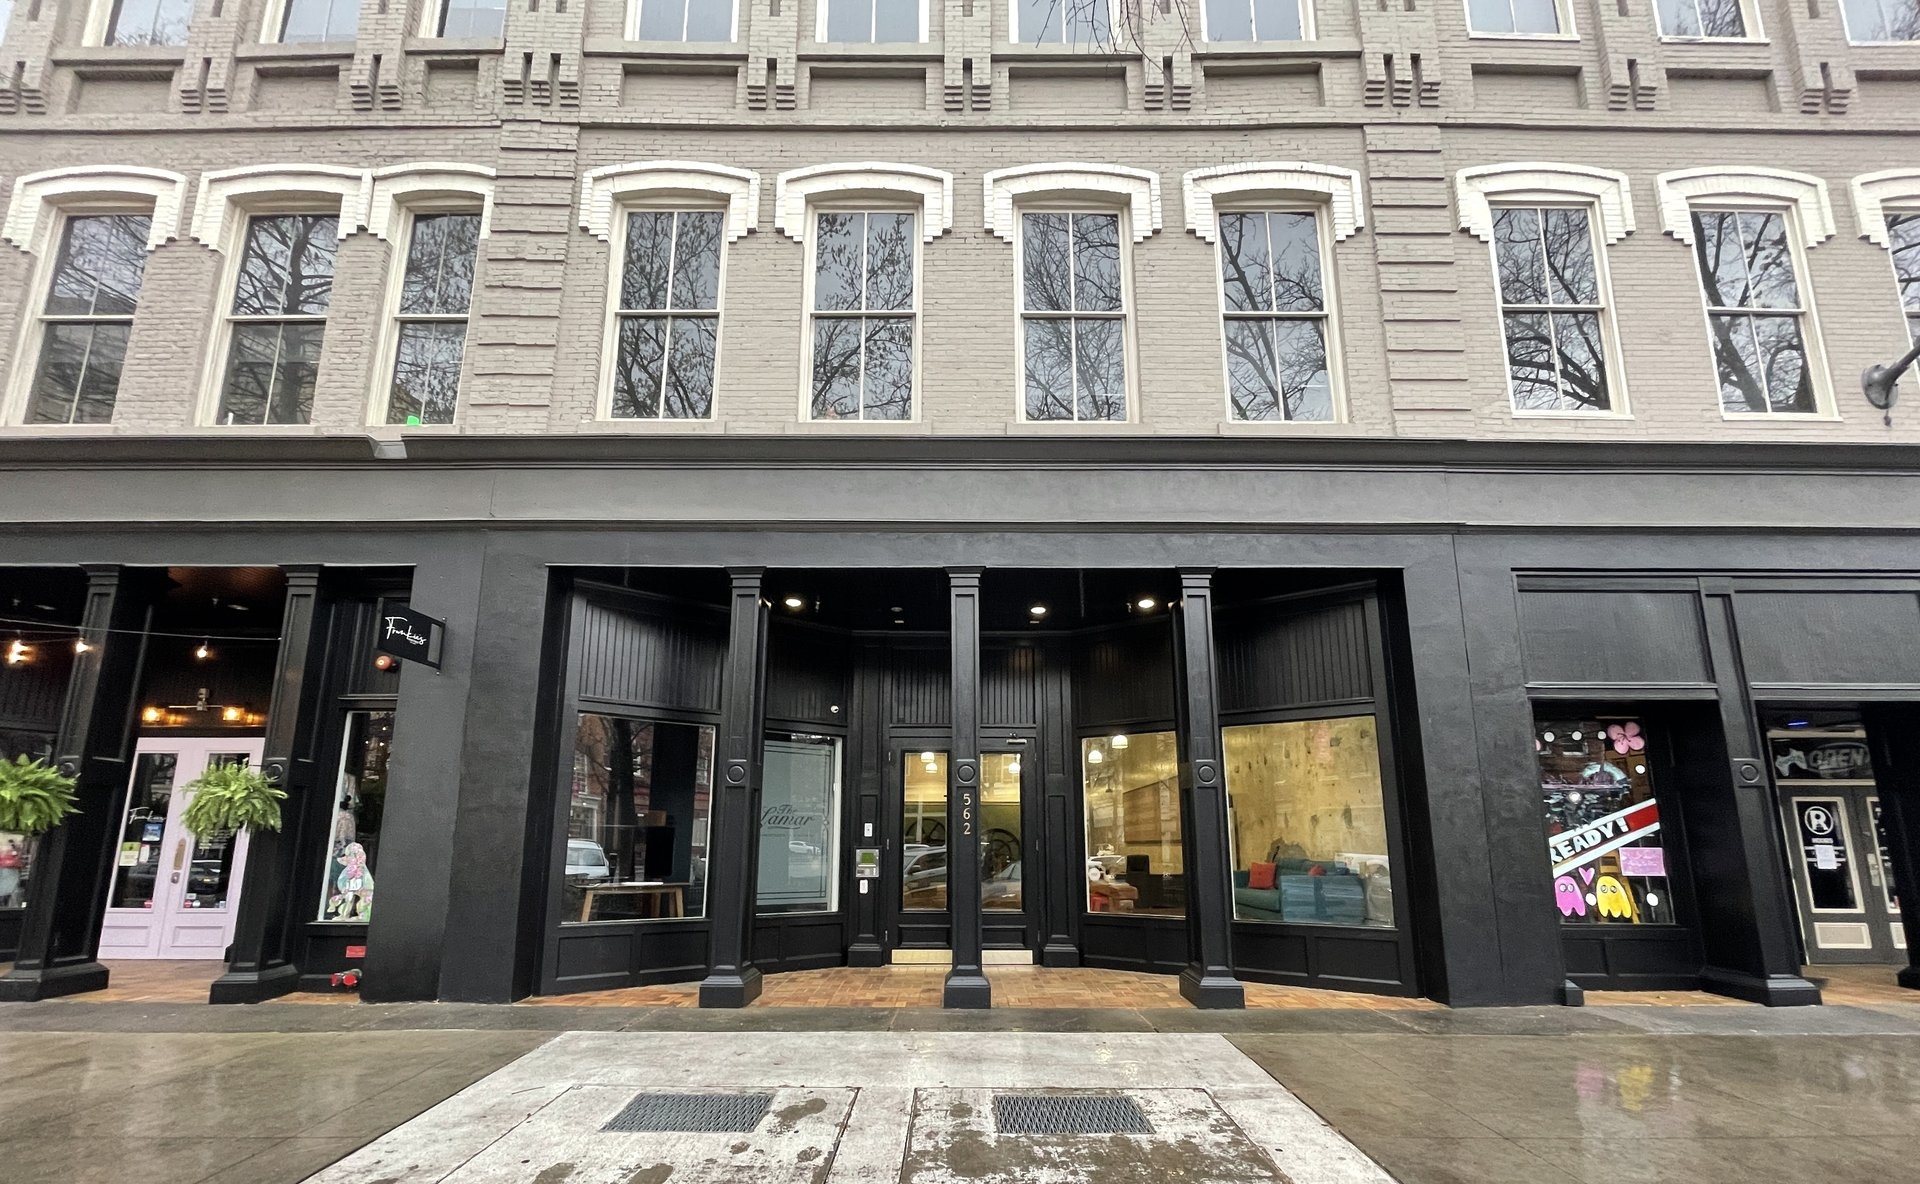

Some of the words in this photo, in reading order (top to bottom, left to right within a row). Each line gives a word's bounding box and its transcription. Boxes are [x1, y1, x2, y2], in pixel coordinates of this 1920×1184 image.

[1809, 748, 1865, 768] OPEN
[760, 806, 813, 829] Lamar
[776, 804, 798, 815] The
[963, 793, 971, 835] 562
